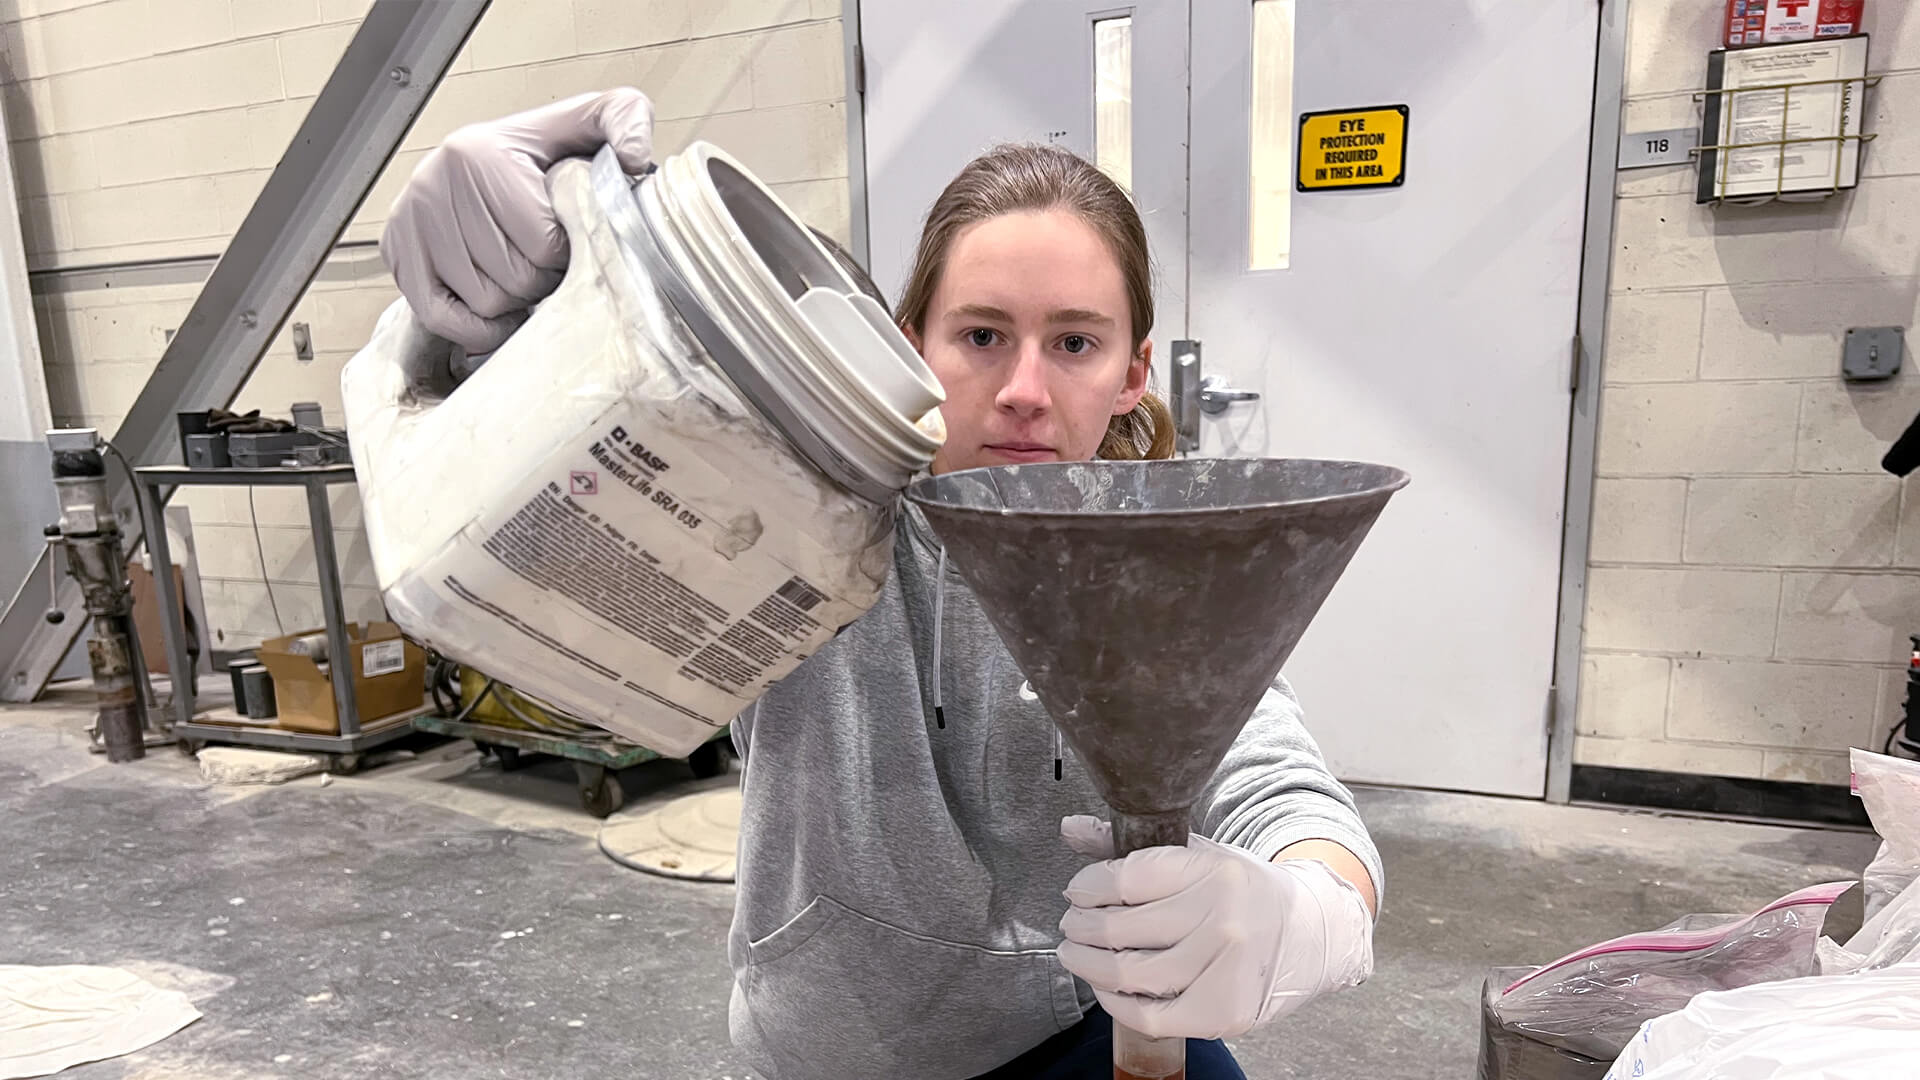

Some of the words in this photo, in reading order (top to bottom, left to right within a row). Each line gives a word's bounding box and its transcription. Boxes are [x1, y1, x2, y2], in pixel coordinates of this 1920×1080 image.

[1339, 119, 1365, 133] EYE
[1320, 133, 1385, 150] PROTECTION
[1646, 139, 1669, 153] 118
[1324, 149, 1378, 164] REQUIRED
[1315, 168, 1328, 180] IN
[1330, 166, 1353, 179] THIS
[1356, 164, 1383, 178] AREA
[629, 442, 671, 473] BASF
[588, 441, 652, 496] MasterLife
[650, 490, 679, 515] SRA
[677, 510, 702, 529] 035
